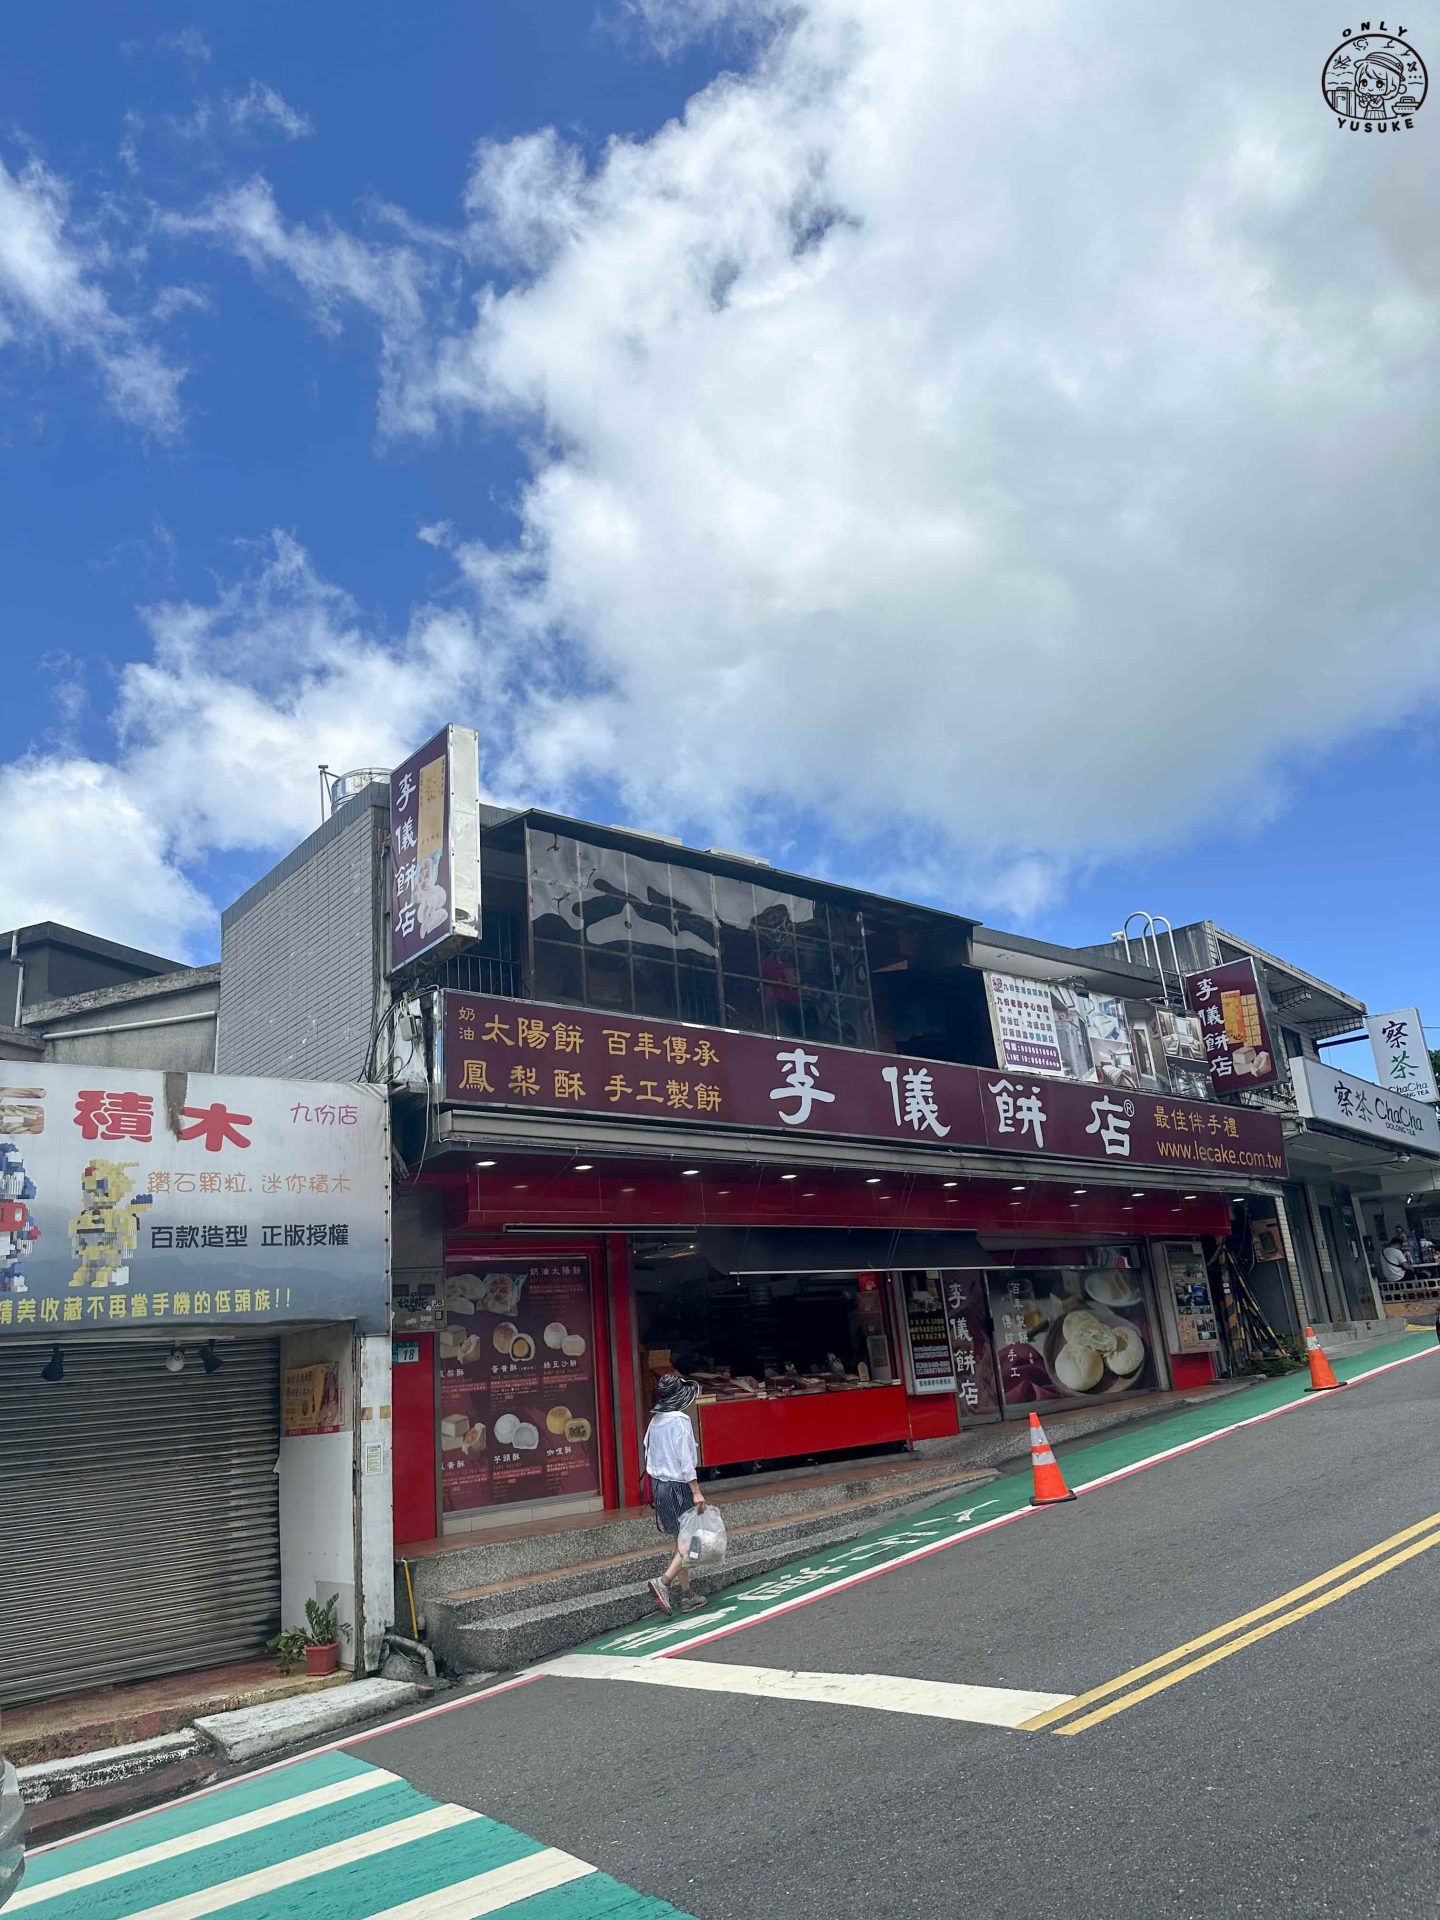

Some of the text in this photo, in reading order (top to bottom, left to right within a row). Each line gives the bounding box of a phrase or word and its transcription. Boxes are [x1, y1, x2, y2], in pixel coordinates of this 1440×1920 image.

[395, 771, 418, 939] 李儀餅店
[458, 1006, 476, 1042] 奶油
[481, 1014, 721, 1068] 太陽餅 百年傳承
[1195, 978, 1233, 1078] 李儀餅店
[1382, 1020, 1419, 1080] 察茶
[458, 1059, 723, 1113] 鳳梨酥 手工製餅
[769, 1047, 1132, 1158] 李儀餅店
[1334, 1080, 1425, 1132] 察茶 ChaCha
[290, 1101, 359, 1126] 九份店
[1153, 1104, 1240, 1139] 最佳伴手禮
[1156, 1138, 1283, 1170] www.lecake.com.tw
[151, 1223, 350, 1249] 百款造型 正版授權
[402, 1348, 415, 1361] 18
[948, 1282, 979, 1407] 李儀餅店
